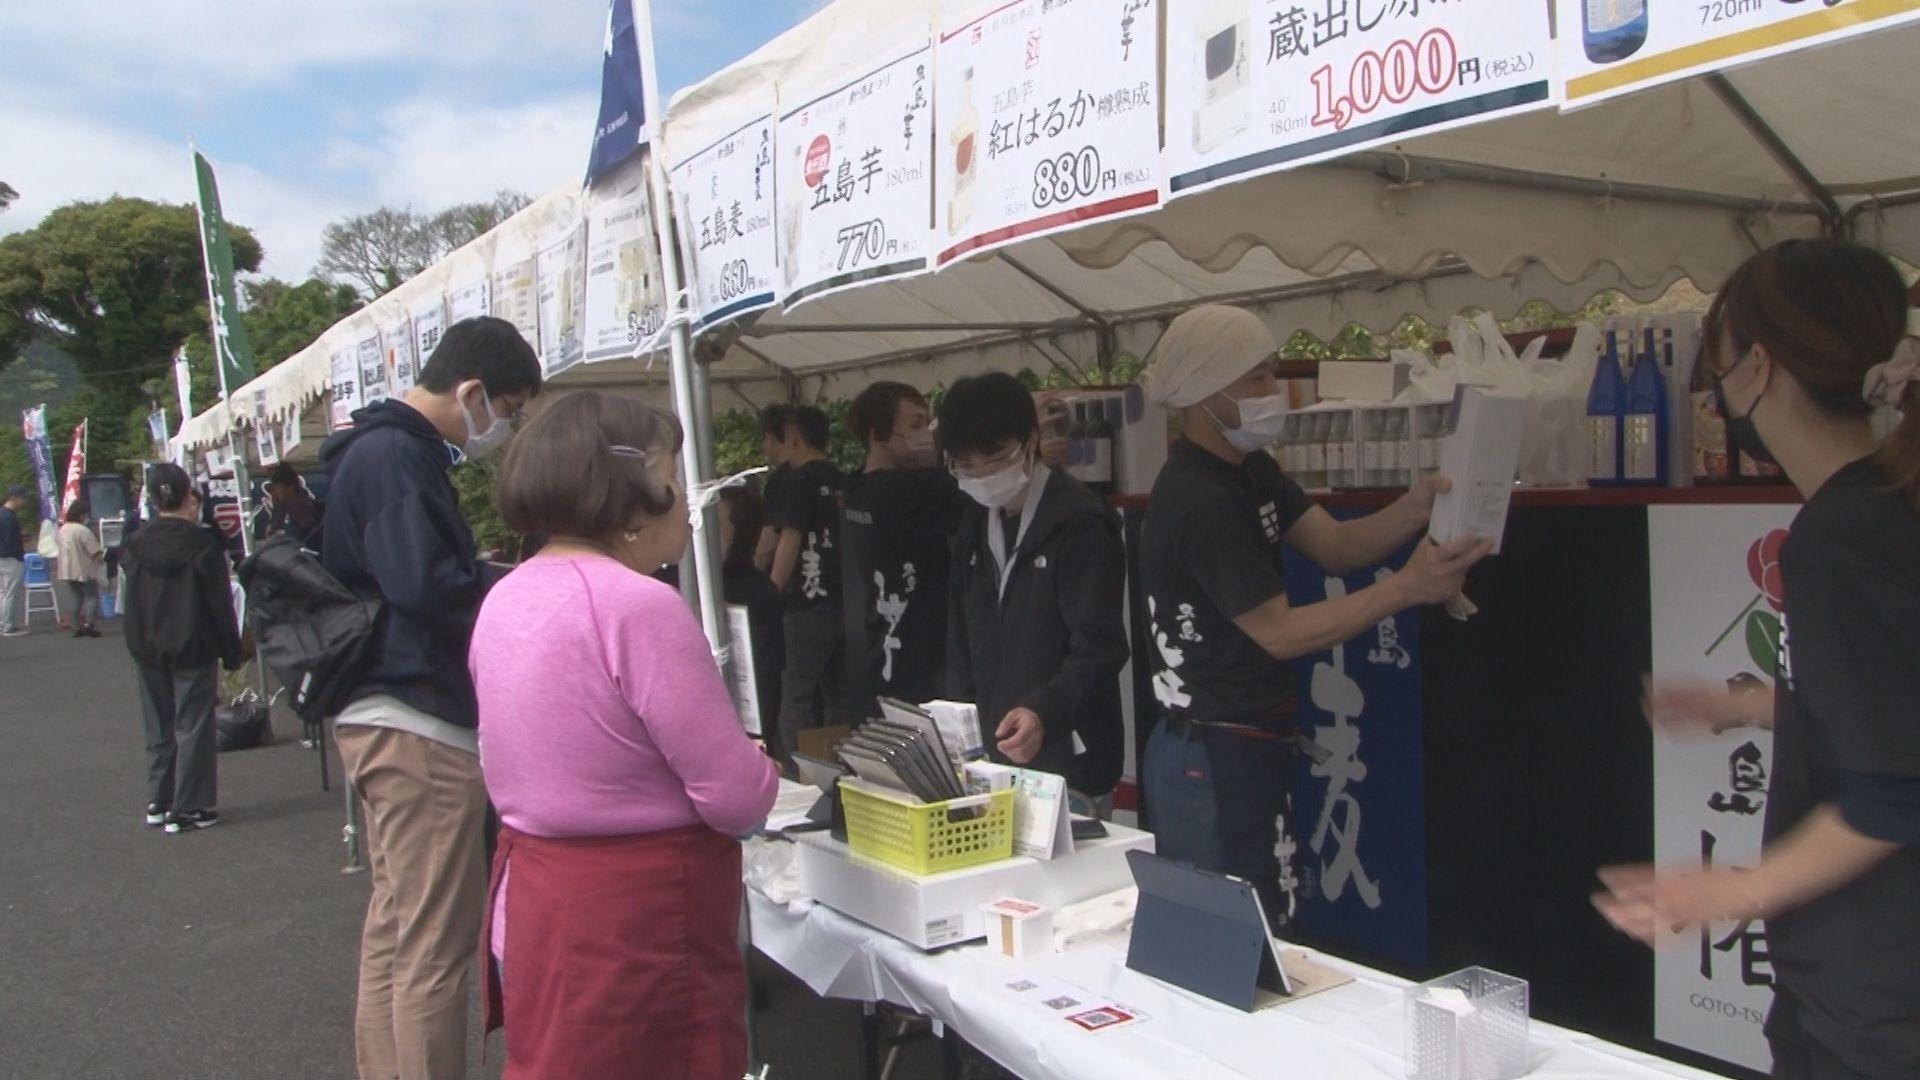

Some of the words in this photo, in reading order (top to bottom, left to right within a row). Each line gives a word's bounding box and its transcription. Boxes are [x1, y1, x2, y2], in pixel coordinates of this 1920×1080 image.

[1266, 0, 1461, 66] 蔵出し
[987, 89, 1096, 160] 紅はるか
[810, 146, 883, 210] 五島芋
